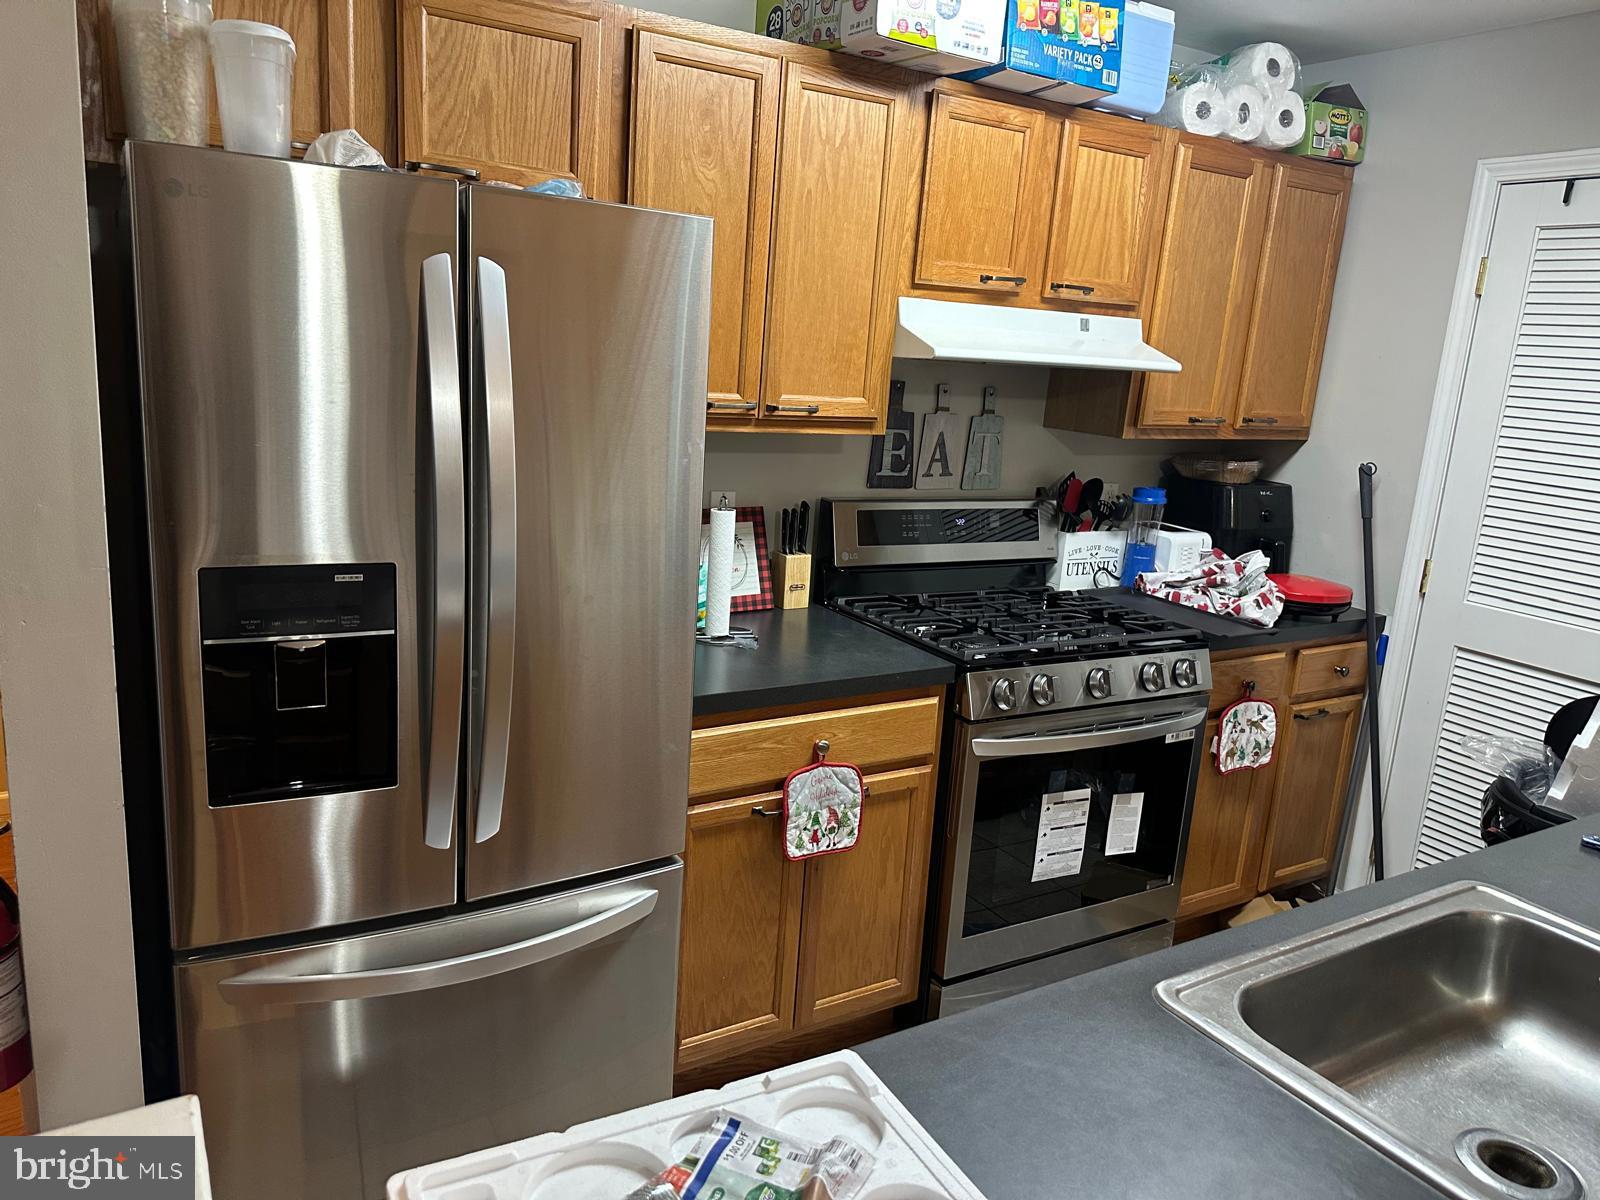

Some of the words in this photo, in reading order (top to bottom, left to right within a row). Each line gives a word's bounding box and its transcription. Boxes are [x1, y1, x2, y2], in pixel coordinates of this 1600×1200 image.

[769, 11, 782, 31] 28
[1043, 42, 1073, 61] VARIETY
[1074, 52, 1093, 67] PACK
[187, 183, 209, 198] LG
[849, 552, 858, 560] LG
[1067, 547, 1082, 557] LIVE
[1104, 545, 1120, 555] COOK
[1066, 559, 1118, 576] UTENSILS
[735, 1131, 749, 1147] OFF
